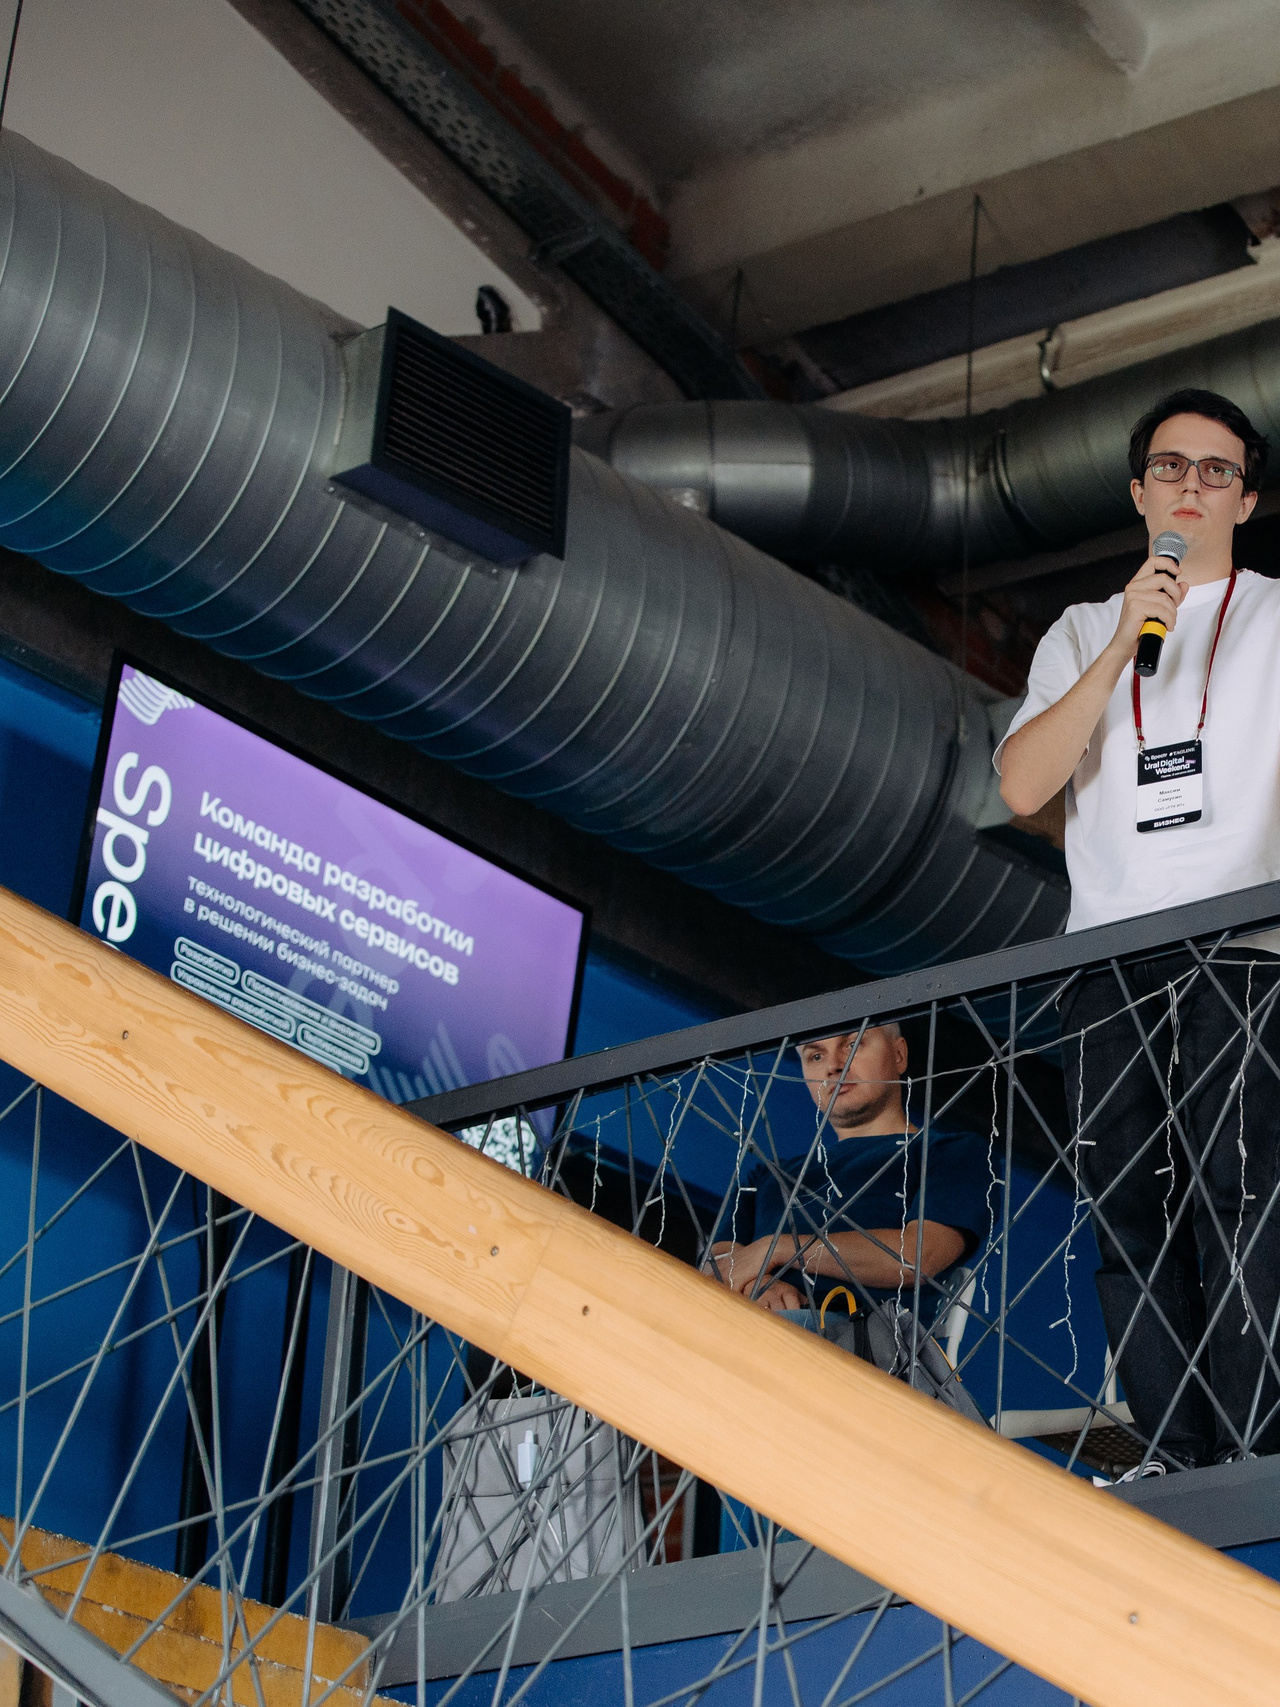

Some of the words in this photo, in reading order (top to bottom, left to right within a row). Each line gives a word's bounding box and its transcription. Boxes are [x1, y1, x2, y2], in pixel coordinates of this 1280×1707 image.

[1144, 761, 1159, 770] Ural
[1160, 756, 1185, 767] Digital
[1155, 763, 1190, 775] Weekend
[92, 751, 172, 950] Spe
[193, 832, 337, 923] цифровых
[339, 908, 460, 986] сервисов
[200, 791, 322, 876] Команда
[323, 861, 475, 957] разработки
[183, 897, 195, 914] в
[197, 904, 274, 954] решении
[276, 942, 388, 1011] бизнес-задач
[188, 876, 330, 958] технологический
[332, 950, 400, 995] партнер
